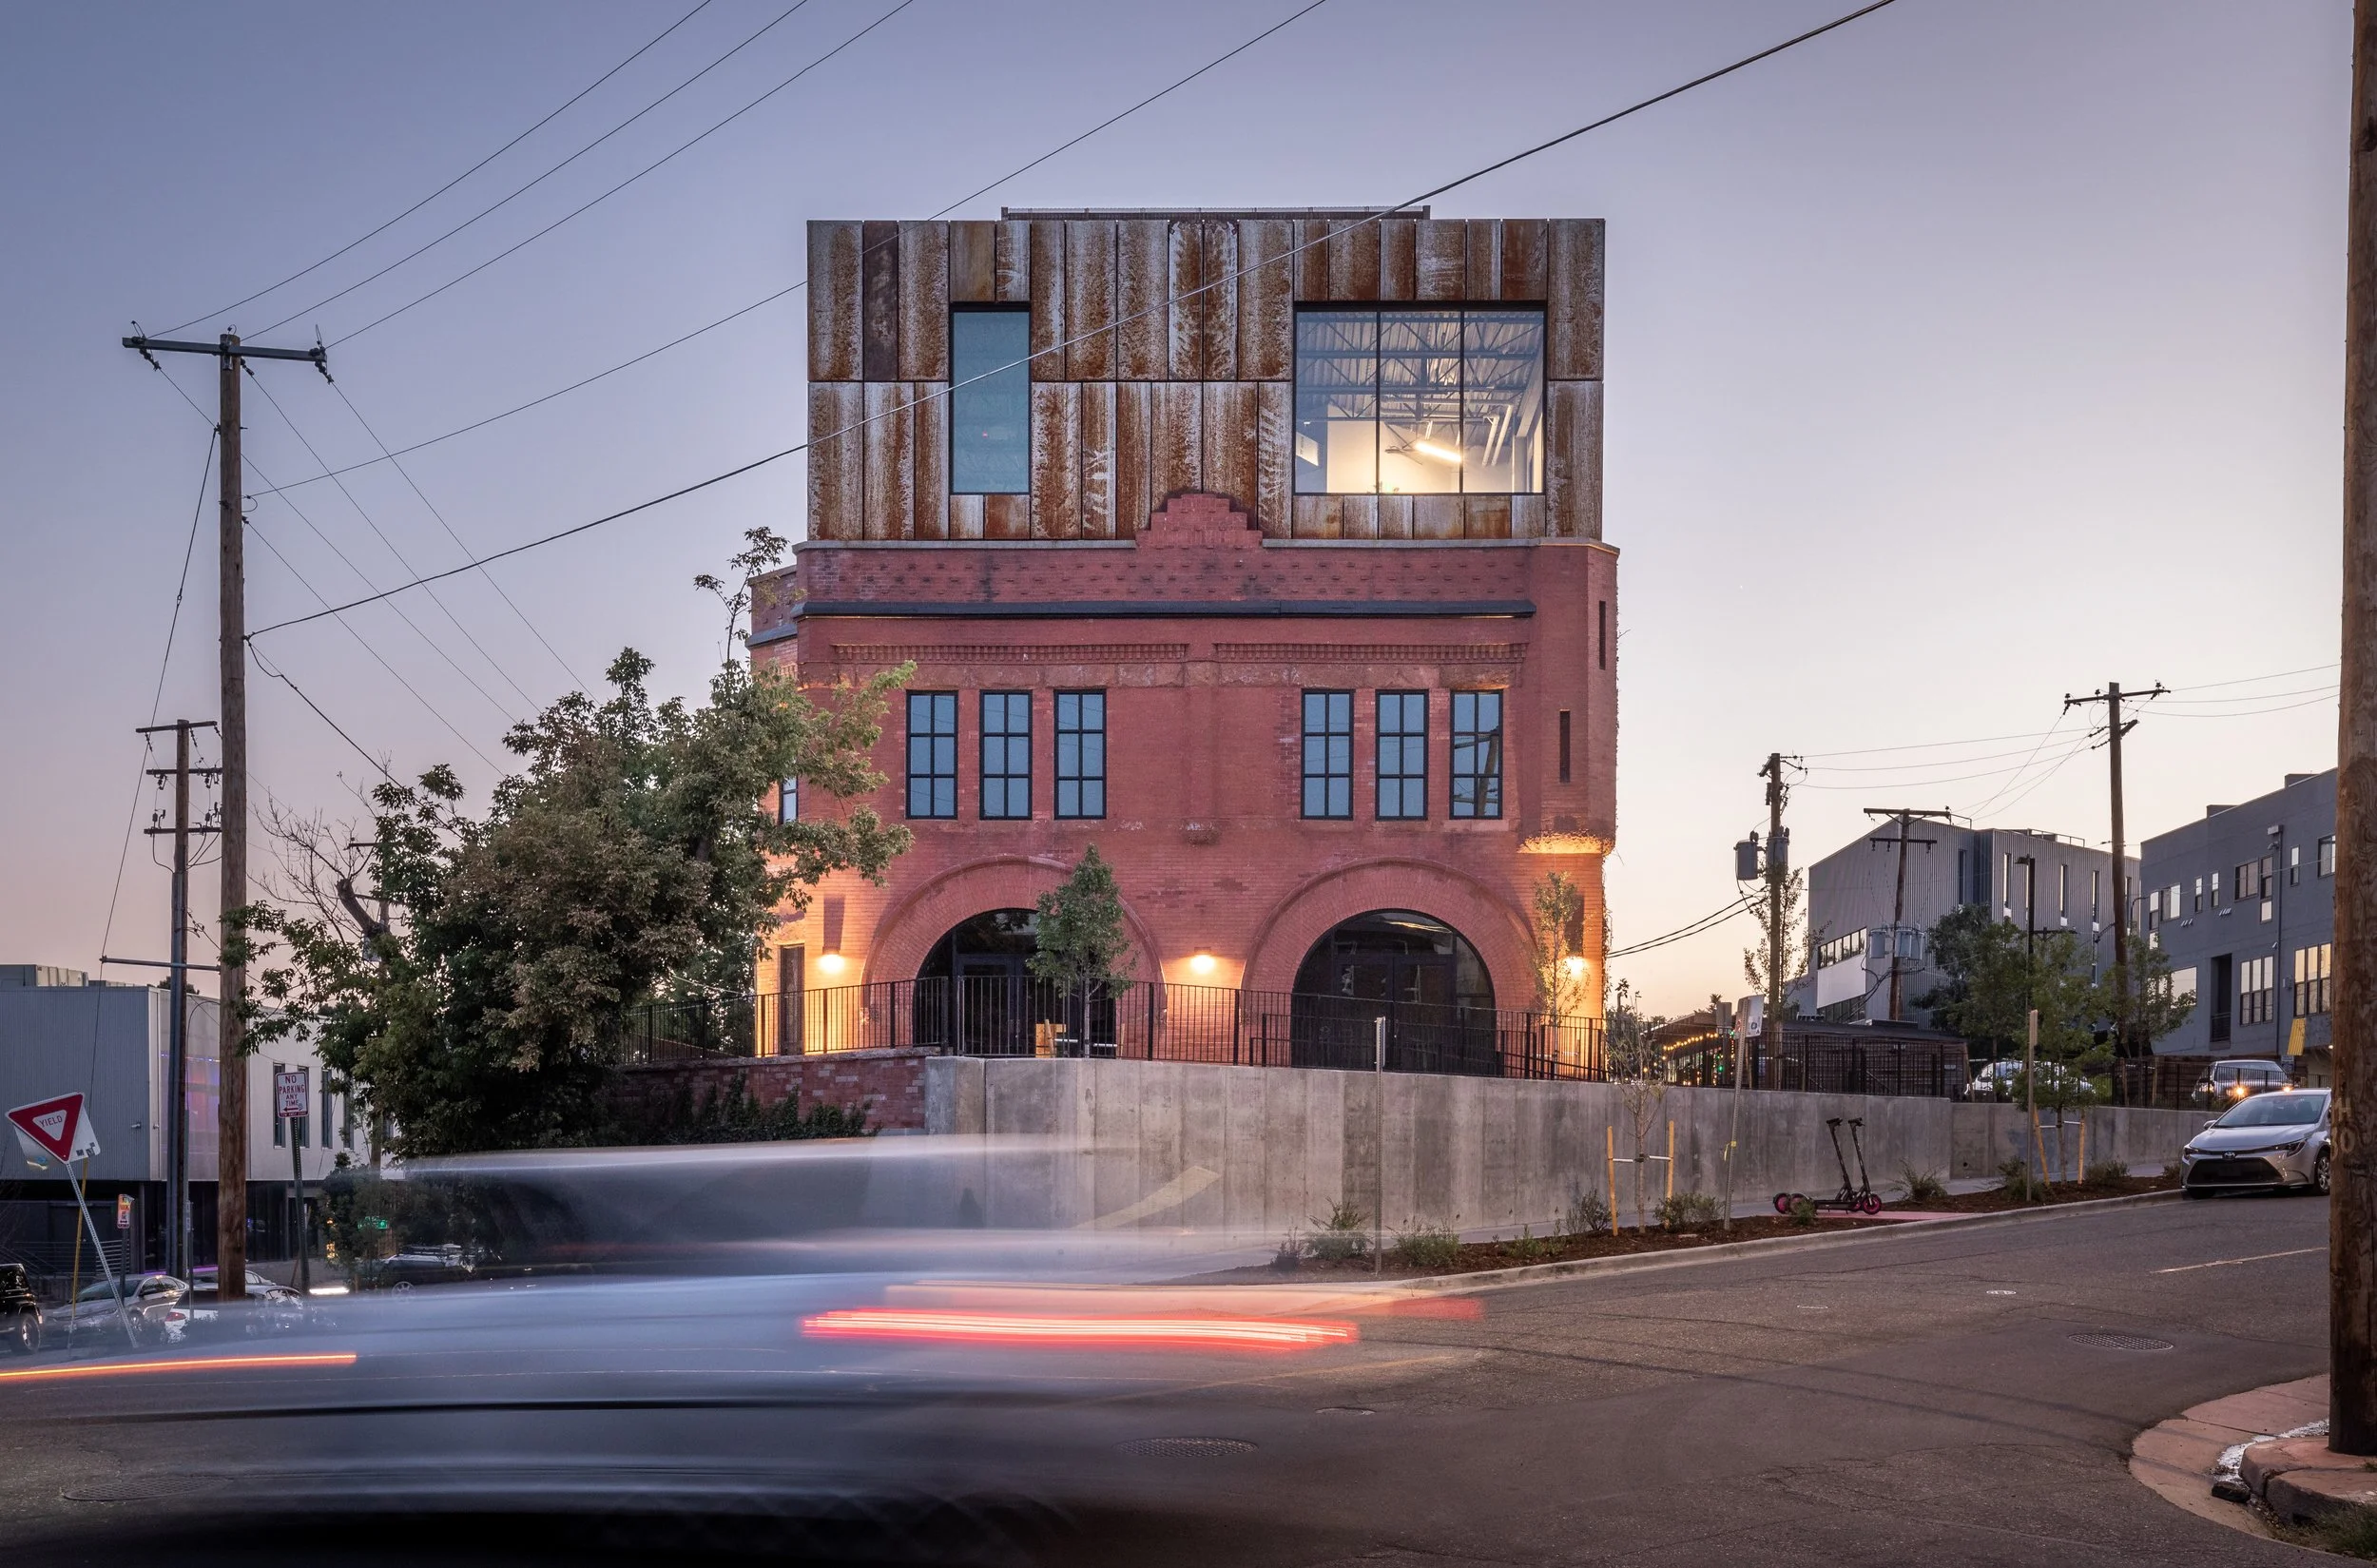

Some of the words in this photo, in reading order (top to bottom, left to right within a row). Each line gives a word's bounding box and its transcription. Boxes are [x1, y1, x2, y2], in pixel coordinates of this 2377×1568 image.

[285, 1075, 297, 1084] NO
[279, 1085, 305, 1094] PARKING
[39, 1115, 63, 1128] YIELD
